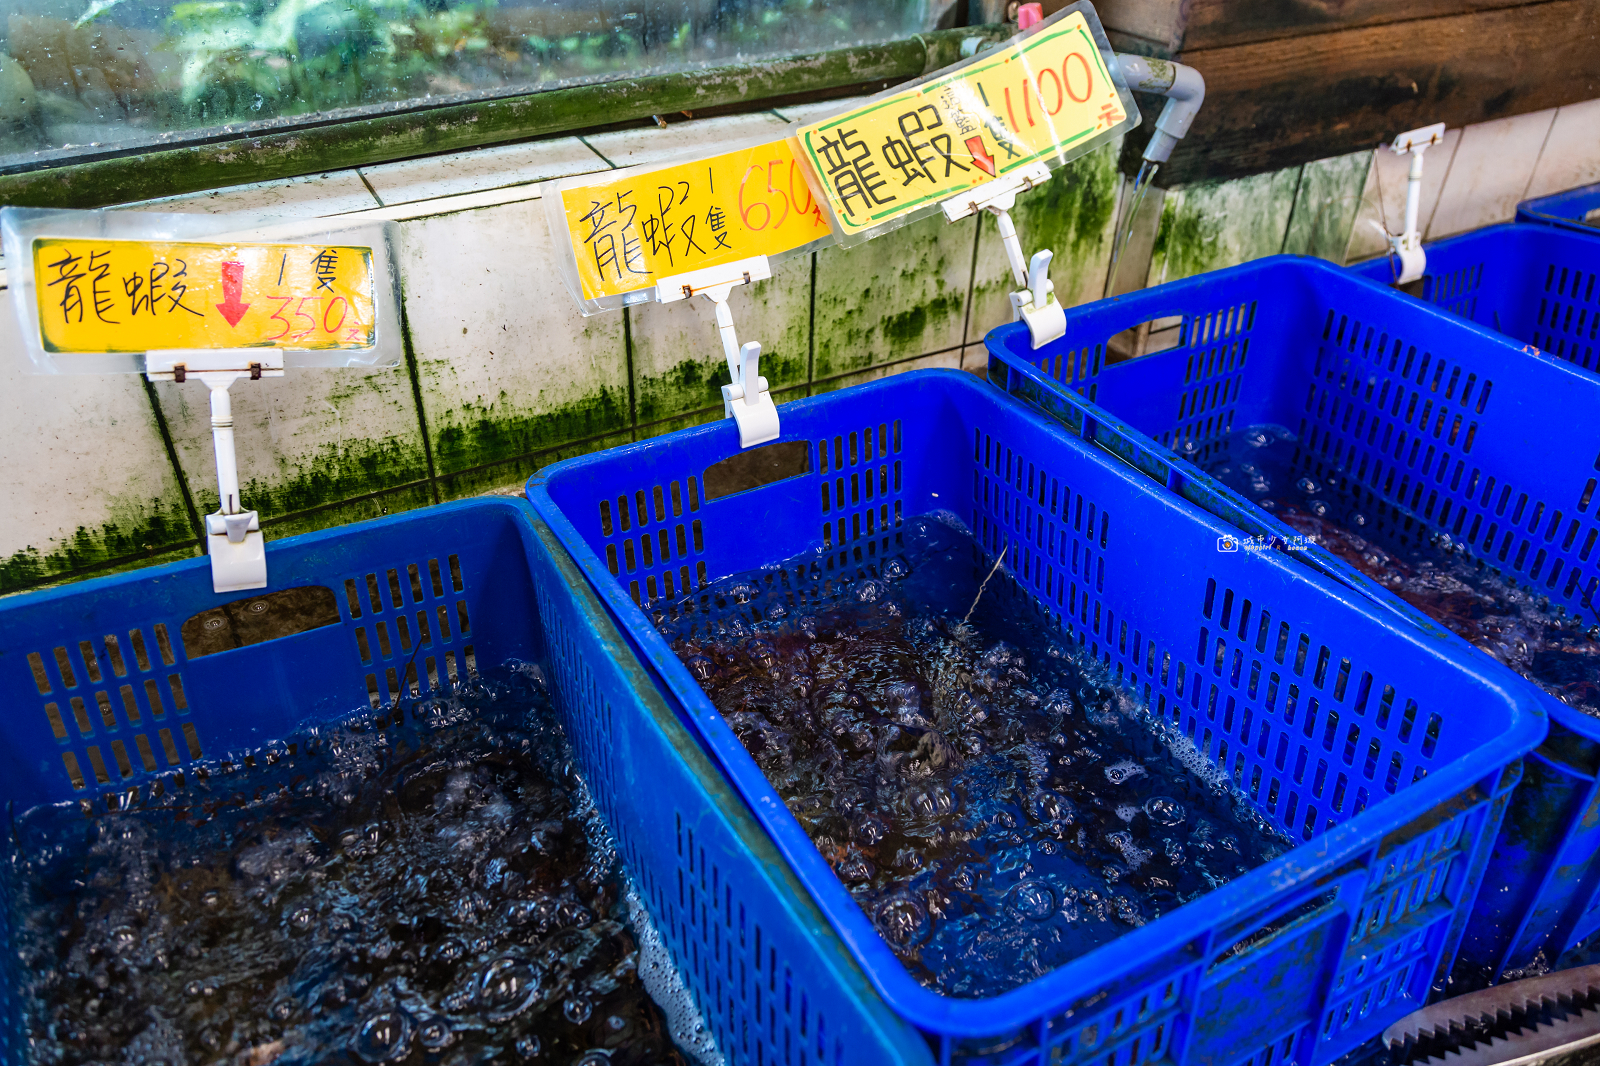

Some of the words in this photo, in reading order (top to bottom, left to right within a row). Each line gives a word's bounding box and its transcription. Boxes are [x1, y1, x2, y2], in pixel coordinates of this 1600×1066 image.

[816, 104, 971, 217] 龍蝦
[579, 181, 707, 282] 龍蝦
[47, 249, 205, 325] 龍蝦
